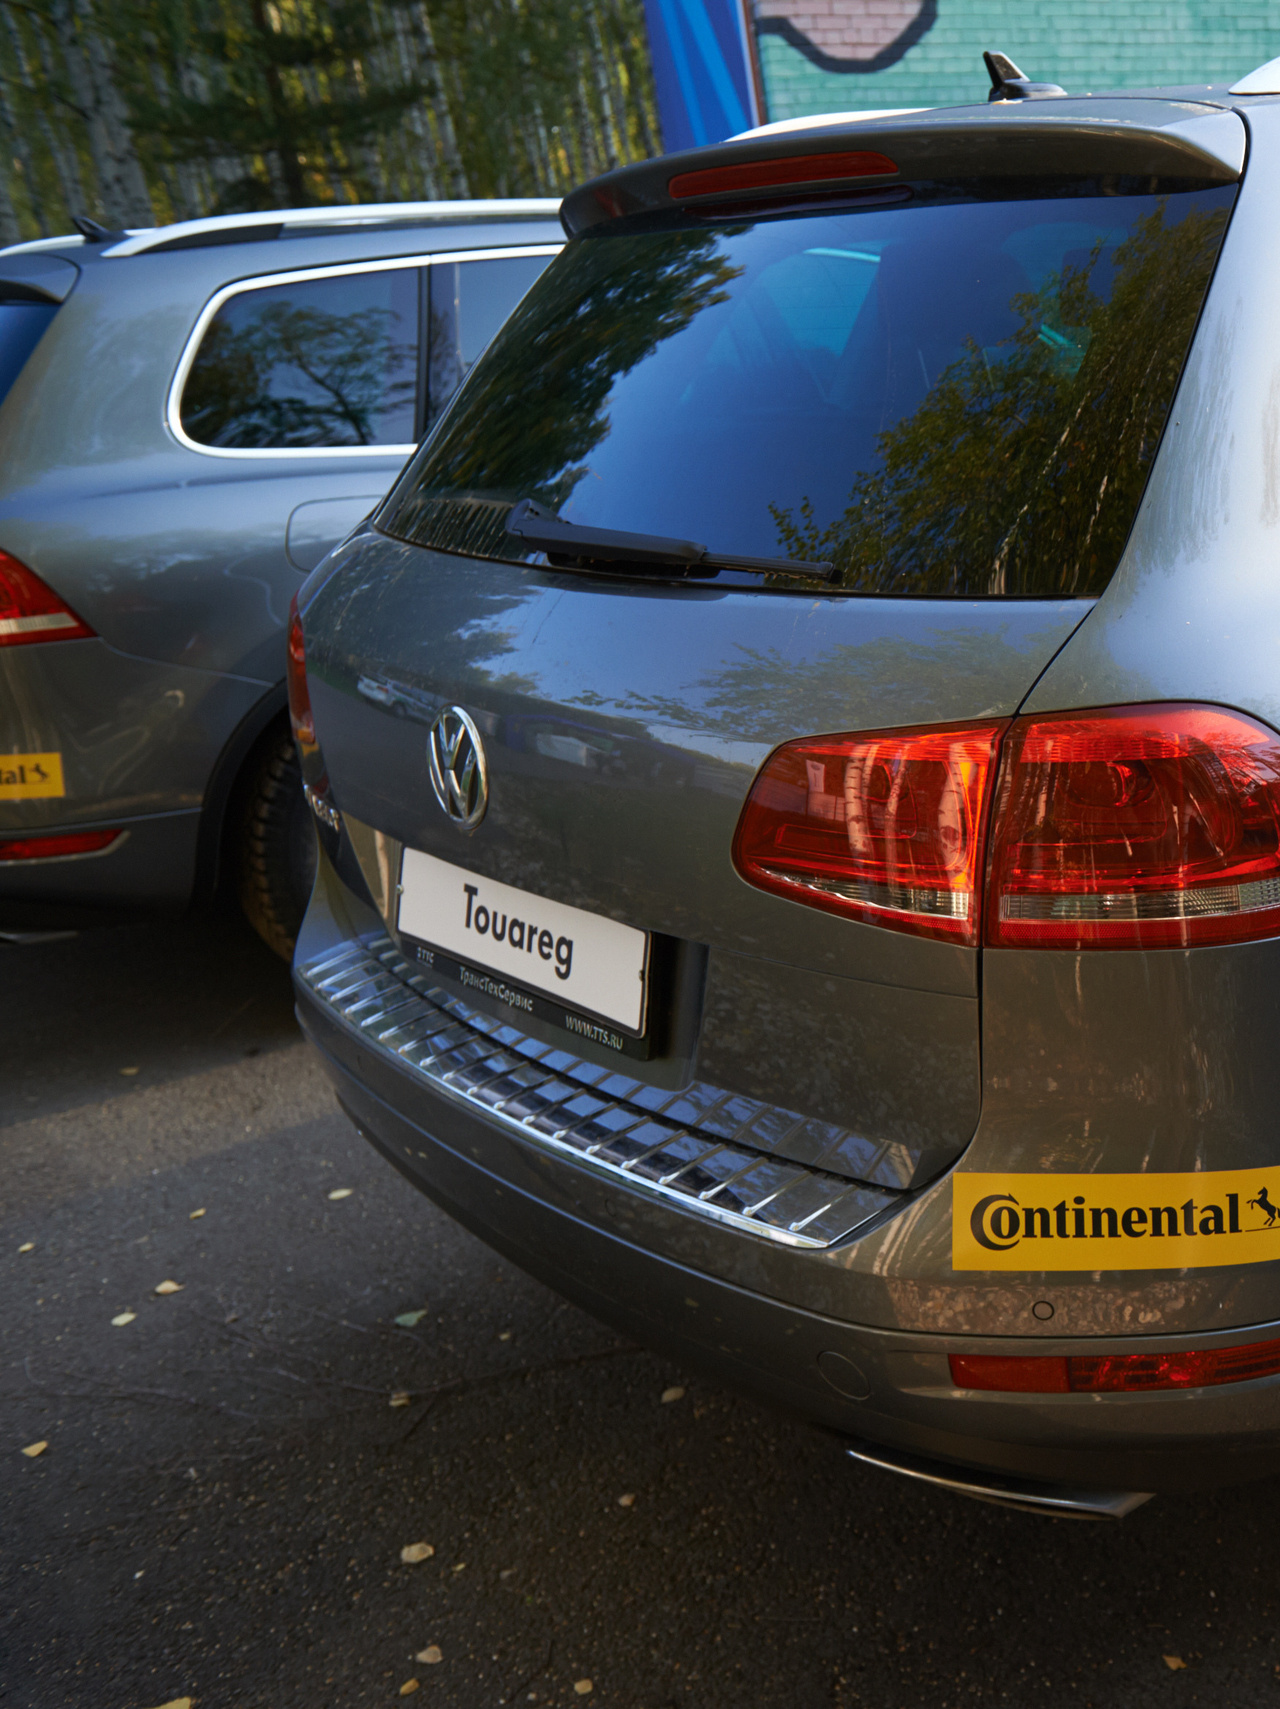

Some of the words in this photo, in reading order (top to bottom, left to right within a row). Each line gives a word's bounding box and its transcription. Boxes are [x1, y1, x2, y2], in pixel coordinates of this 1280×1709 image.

[463, 883, 574, 980] Touareg
[459, 965, 533, 1012] ТрансТехСервис
[565, 1014, 624, 1050] WWW.TTS.RU
[970, 1192, 1243, 1251] Continental
